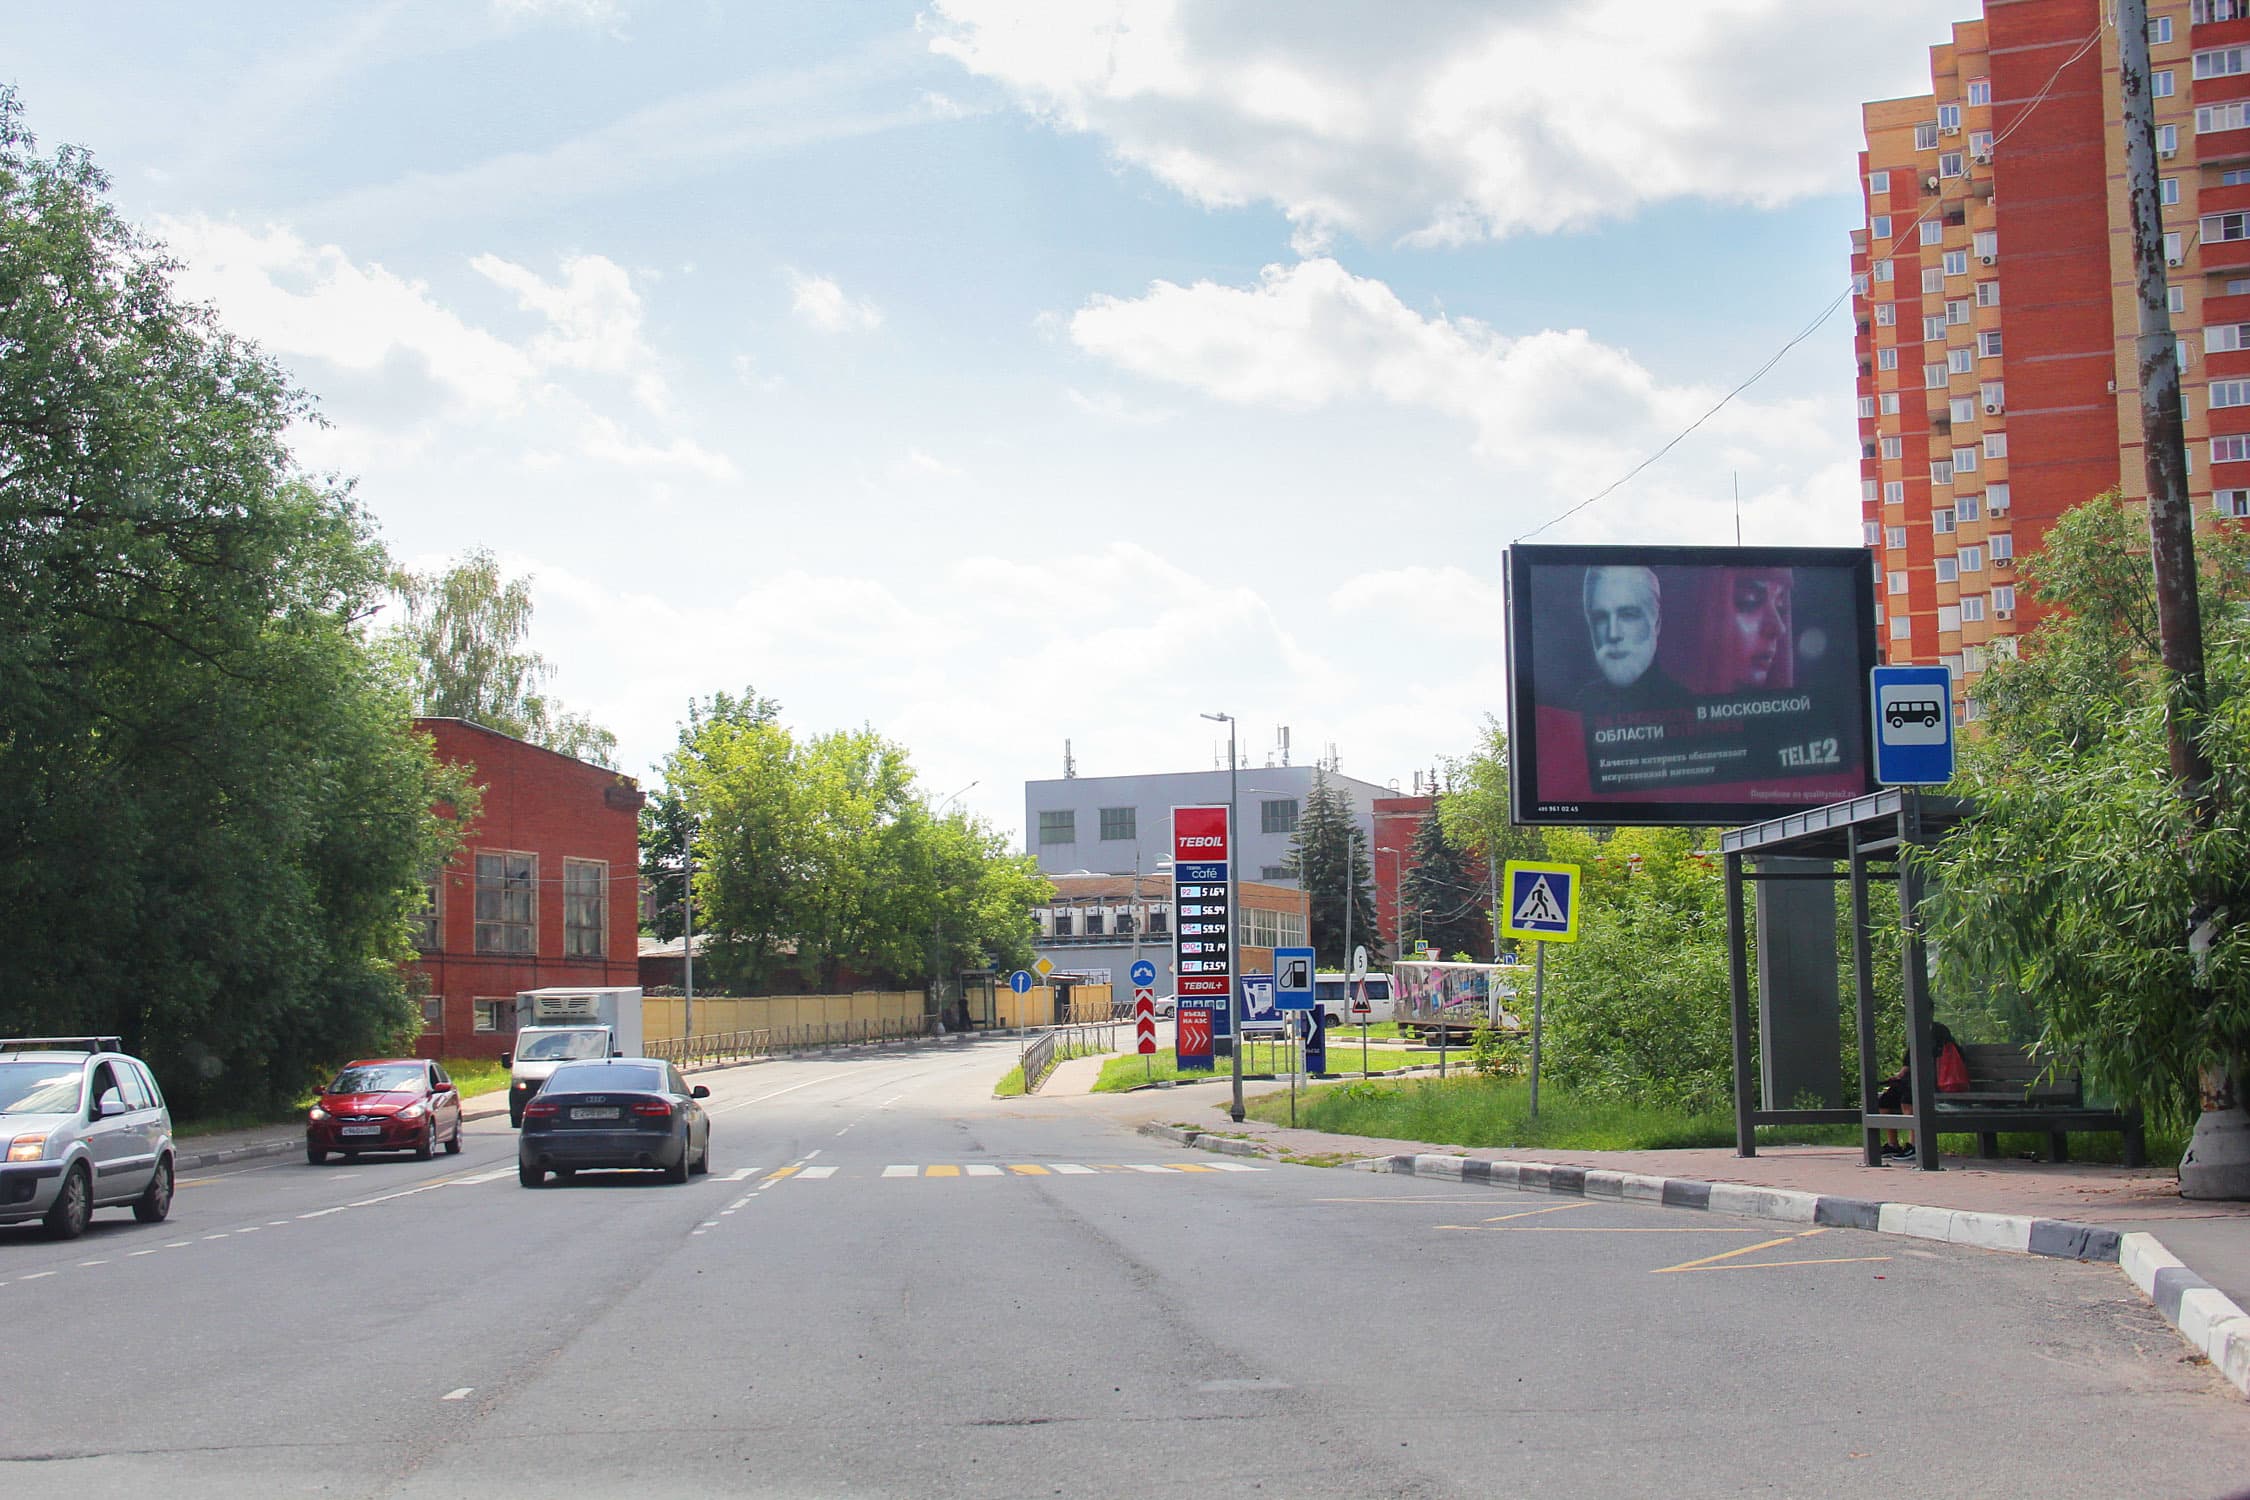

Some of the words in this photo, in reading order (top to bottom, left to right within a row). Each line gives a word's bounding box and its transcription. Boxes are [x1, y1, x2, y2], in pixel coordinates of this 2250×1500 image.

[1696, 706, 1707, 720] В
[1710, 696, 1811, 719] МОСКОВСКОЙ
[1595, 725, 1664, 743] ОБЛАСТИ
[1778, 737, 1841, 767] TELE2
[1179, 836, 1224, 848] TEBOIL
[1191, 867, 1218, 879] café
[1182, 888, 1192, 896] 92
[1184, 982, 1223, 990] TEBOIL+
